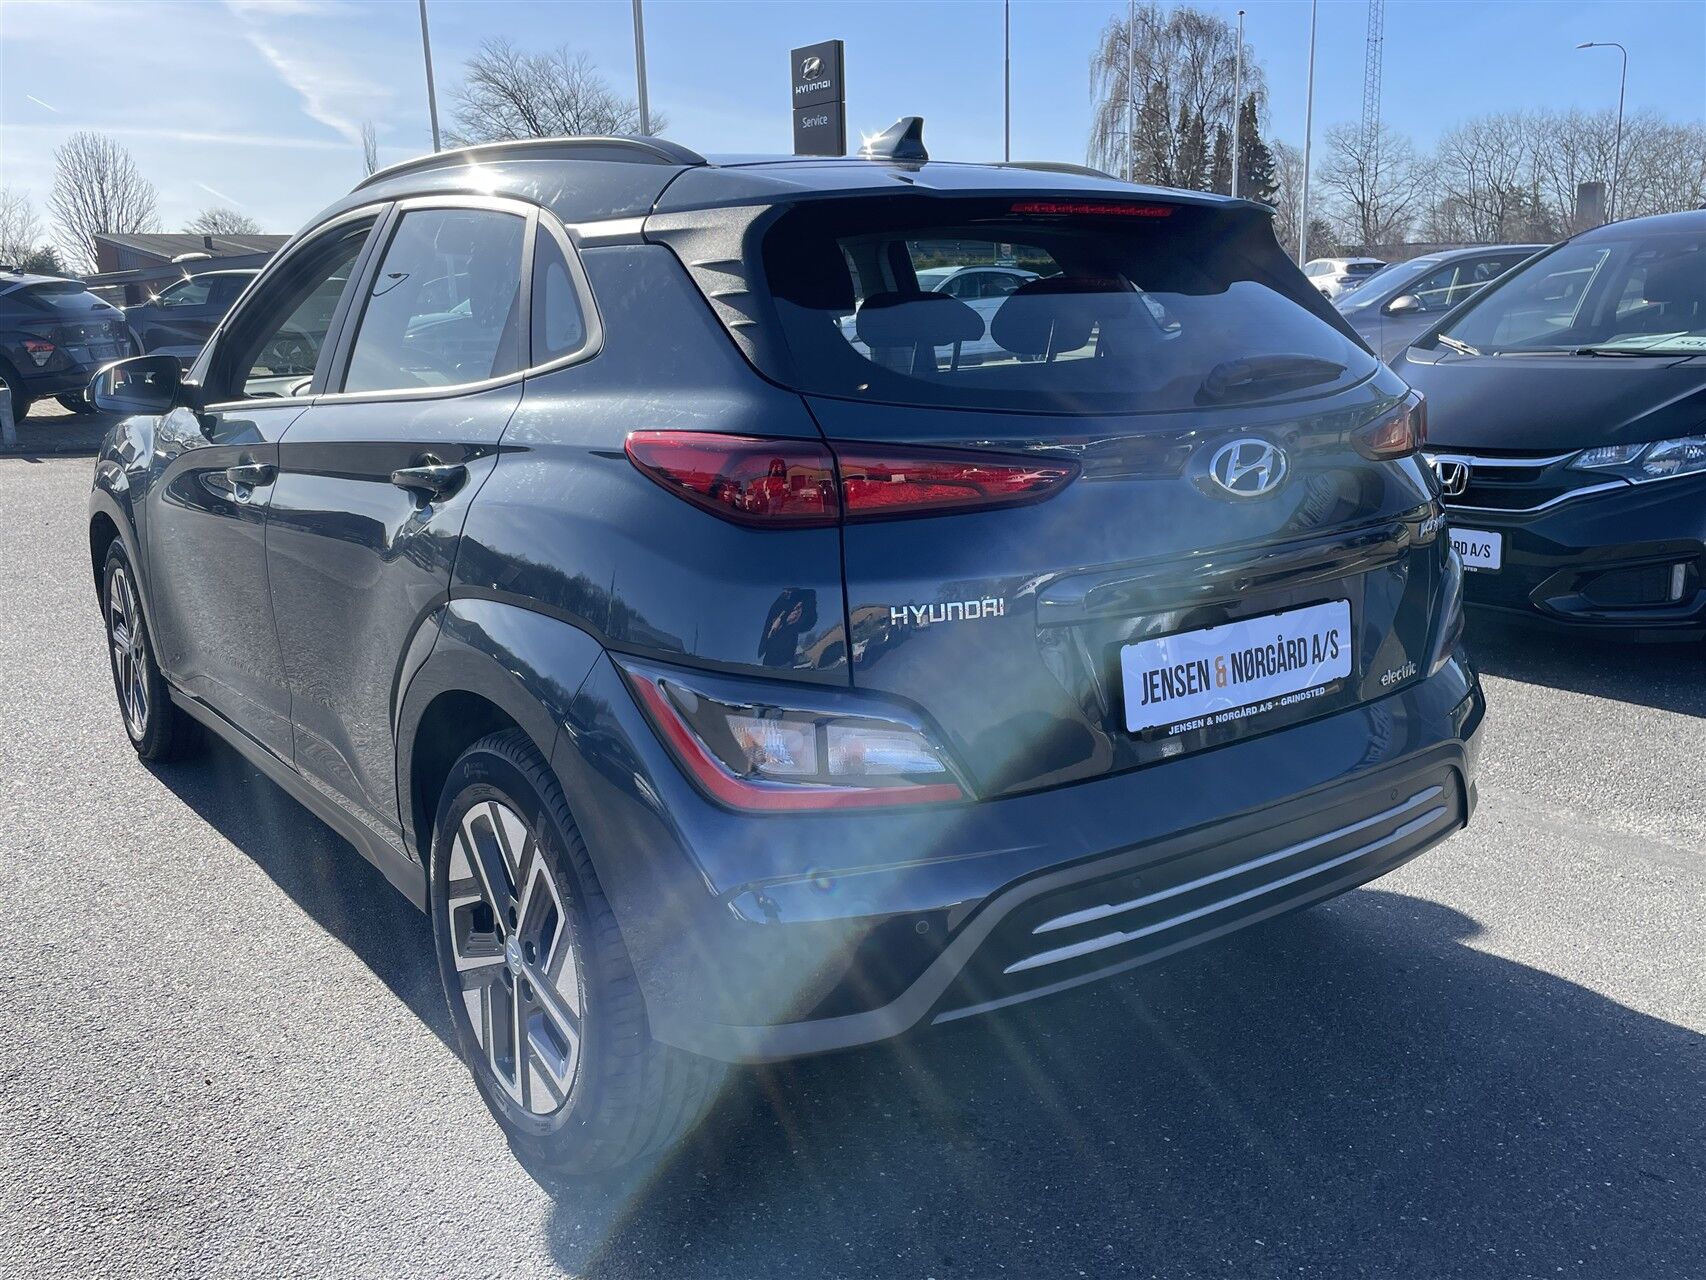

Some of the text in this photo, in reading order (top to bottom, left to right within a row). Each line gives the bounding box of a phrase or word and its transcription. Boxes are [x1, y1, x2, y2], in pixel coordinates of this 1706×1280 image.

[795, 80, 831, 94] HYUNDAI
[802, 114, 828, 128] Service
[1470, 543, 1491, 559] A/S
[890, 598, 1004, 625] HYUNDAI
[1141, 629, 1339, 705] JENSEN & NØRGÅRD A/S
[1381, 661, 1416, 686] electric
[1168, 687, 1325, 735] JENSEN & NØRGÅRD A/S GRINDSTED
